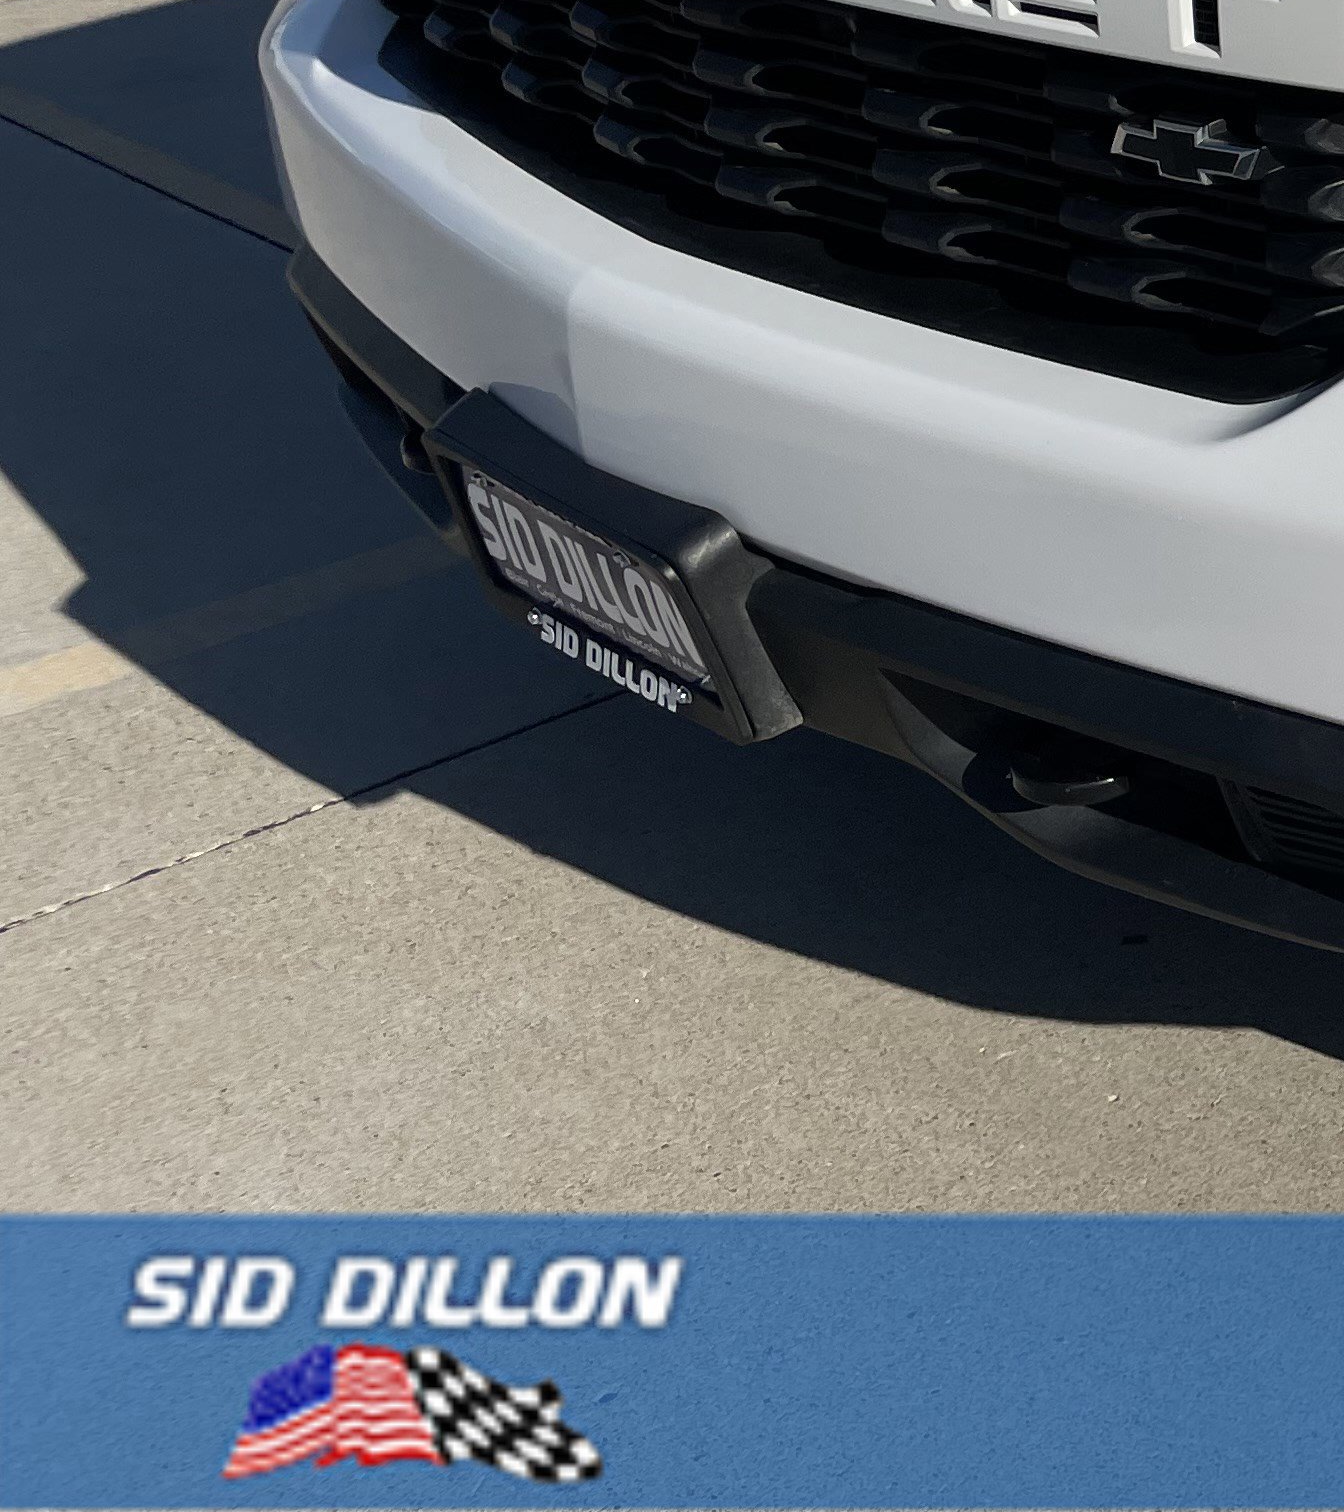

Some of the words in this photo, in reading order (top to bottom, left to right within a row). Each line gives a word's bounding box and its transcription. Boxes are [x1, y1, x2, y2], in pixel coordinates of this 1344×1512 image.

[467, 483, 547, 583] SID
[538, 520, 704, 669] DILLON
[540, 613, 580, 660] SID
[584, 639, 682, 713] DILLON
